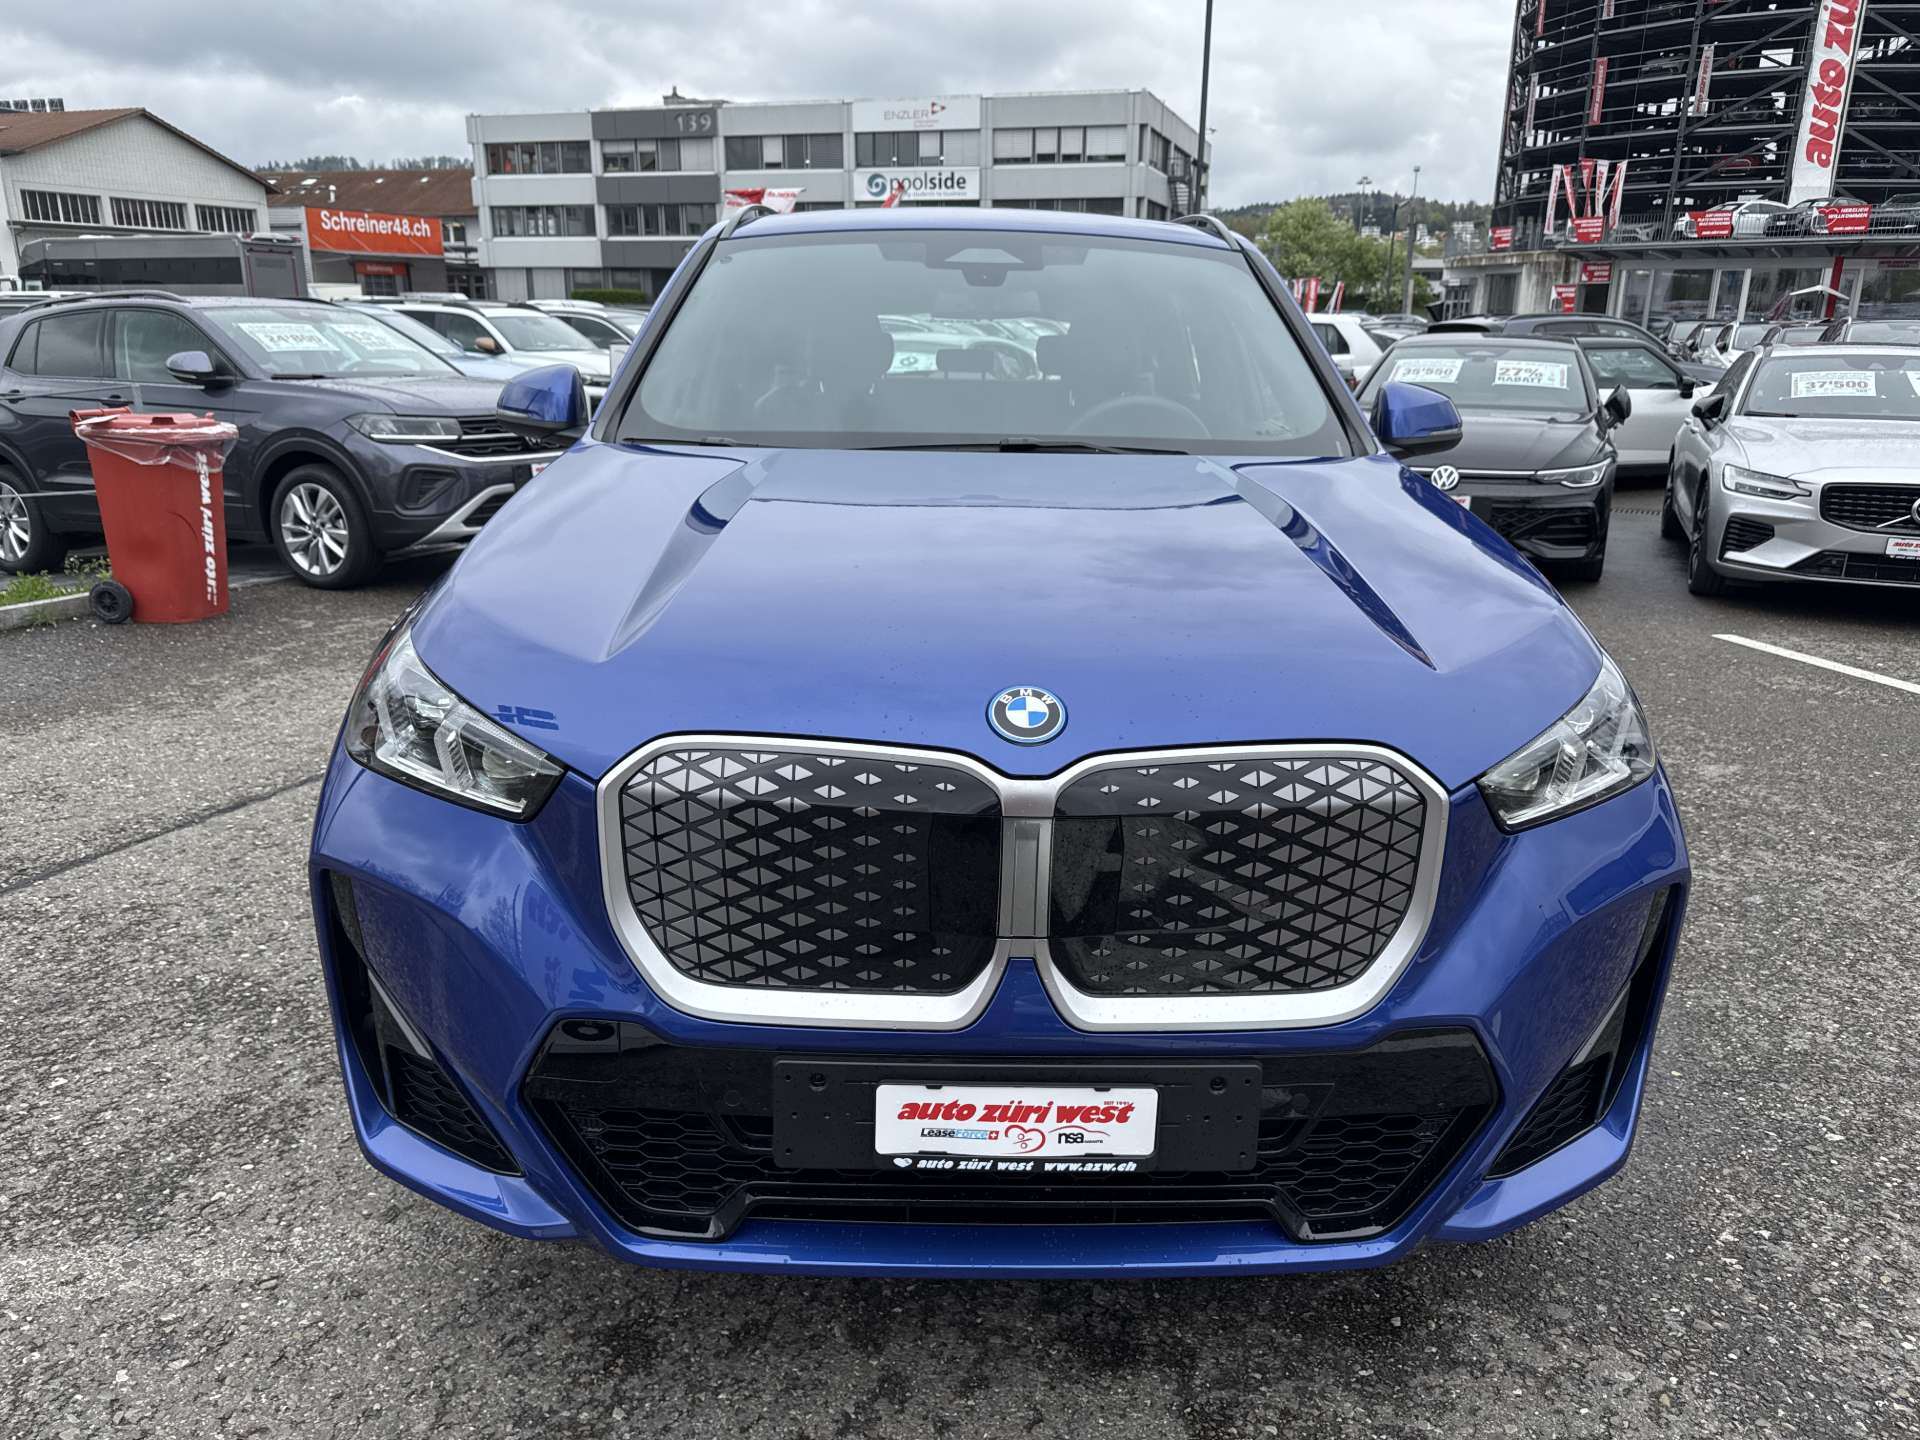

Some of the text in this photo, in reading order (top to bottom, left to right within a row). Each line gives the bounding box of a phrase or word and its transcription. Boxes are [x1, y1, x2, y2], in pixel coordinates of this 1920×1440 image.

[883, 109, 929, 120] ENZLER
[1806, 59, 1846, 168] auto
[676, 113, 712, 132] 139
[889, 171, 967, 200] poolside
[320, 209, 432, 238] Schreiner48.ch
[1499, 367, 1544, 377] 27%
[1806, 380, 1869, 389] 37'500
[1000, 688, 1054, 705] BMW
[897, 1099, 1135, 1123] auto züri west
[920, 1128, 988, 1140] LeaseForce
[1058, 1132, 1084, 1144] nsa
[917, 1158, 1137, 1172] auto züri west www.azw.ch
